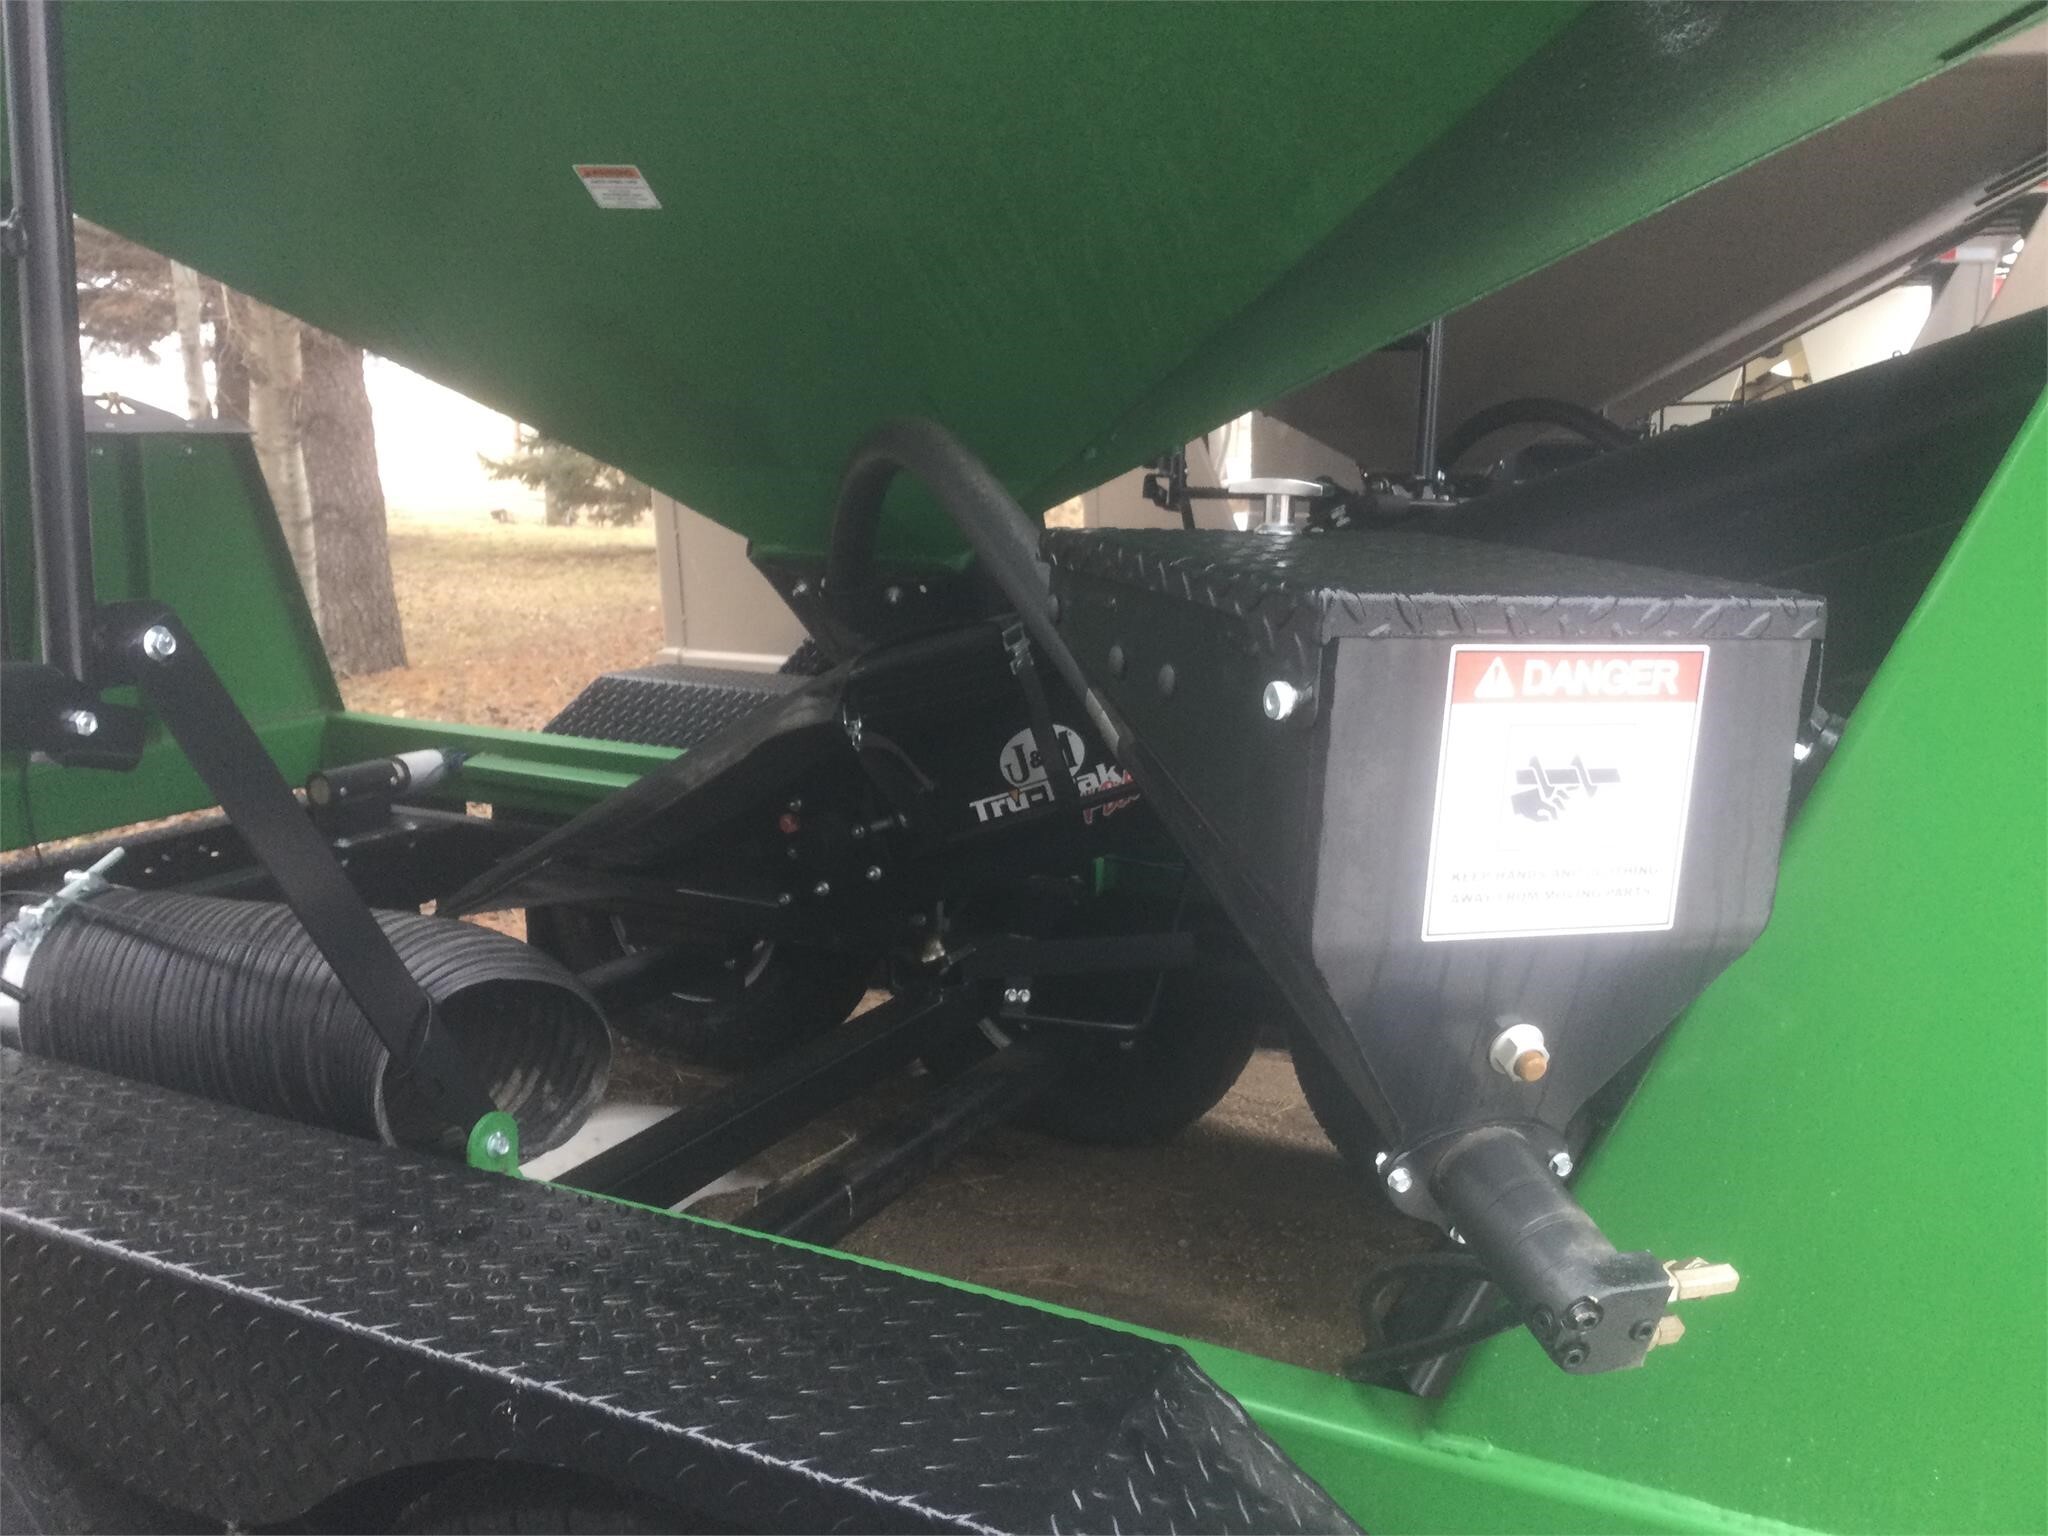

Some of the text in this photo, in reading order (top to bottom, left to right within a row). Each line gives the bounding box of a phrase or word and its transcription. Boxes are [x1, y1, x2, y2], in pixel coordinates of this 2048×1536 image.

[1523, 659, 1679, 696] DANGER
[969, 763, 1121, 822] Tru-Tak
[1495, 870, 1547, 881] HANDS
[1590, 865, 1661, 878] THING
[1497, 890, 1539, 903] ROM
